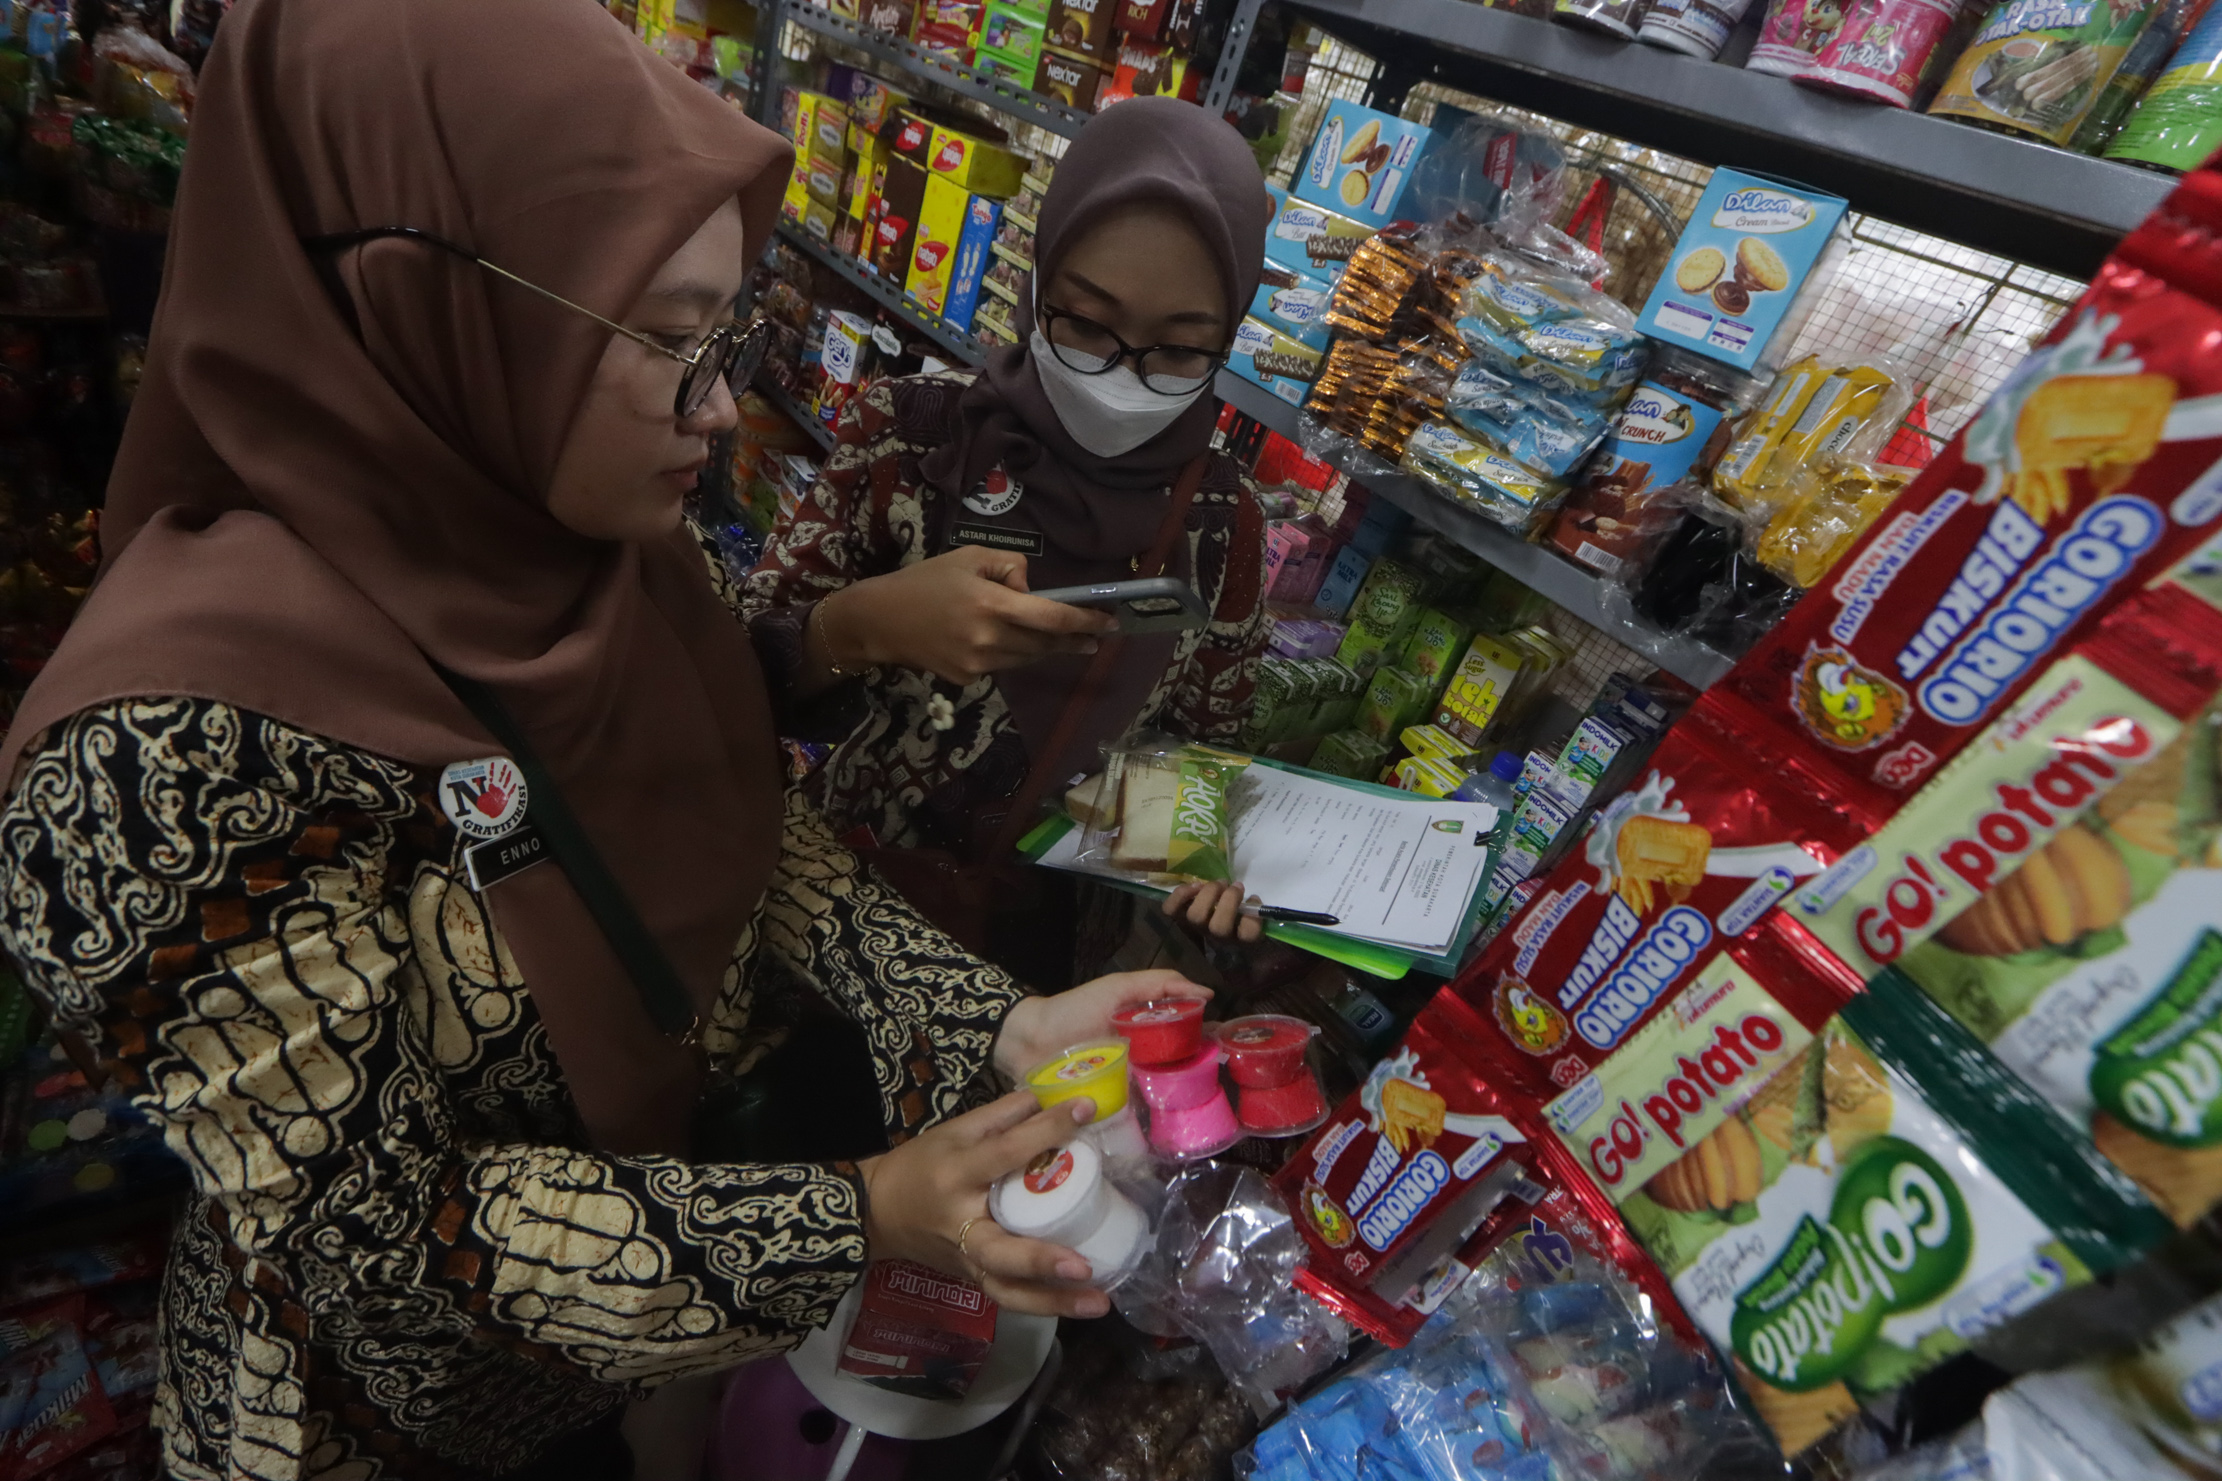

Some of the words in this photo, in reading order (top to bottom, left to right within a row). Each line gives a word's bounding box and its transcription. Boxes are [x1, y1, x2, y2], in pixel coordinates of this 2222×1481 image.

[1127, 4, 1149, 21] RICH
[971, 203, 993, 224] Tango
[1282, 210, 1316, 228] Dilan
[1722, 191, 1791, 213] Dilan
[1735, 215, 1768, 228] Cream
[1621, 424, 1667, 443] CRUNCH
[959, 529, 987, 541] ASTARI
[988, 533, 1036, 548] KHOIRUNISA
[1897, 497, 2046, 681] BISKUIT
[1833, 599, 1871, 640] SUSU
[1921, 499, 2159, 725] GORIORIO
[1463, 661, 1486, 675] Sugar
[1467, 656, 1485, 668] Less
[1581, 720, 1619, 752] INDOMILK
[462, 784, 528, 836] GRATIFIKASI
[1528, 794, 1564, 826] INDOMILK
[1941, 716, 2151, 893] potato
[500, 837, 541, 866] ENNO
[1738, 888, 1773, 925] SIANTAR
[1856, 856, 1946, 965] GO!
[1726, 918, 1743, 933] TOP
[1516, 946, 1536, 975] SUSU
[1556, 890, 1642, 1012] BISKUIT
[1577, 908, 1709, 1049] GORIORIO
[1644, 1016, 1782, 1148] potato
[1591, 1102, 1649, 1185] GO!
[1345, 1132, 1401, 1217] BISKUIT
[1359, 1151, 1449, 1251] GORIORIO
[15, 1373, 92, 1449] Milkuat
